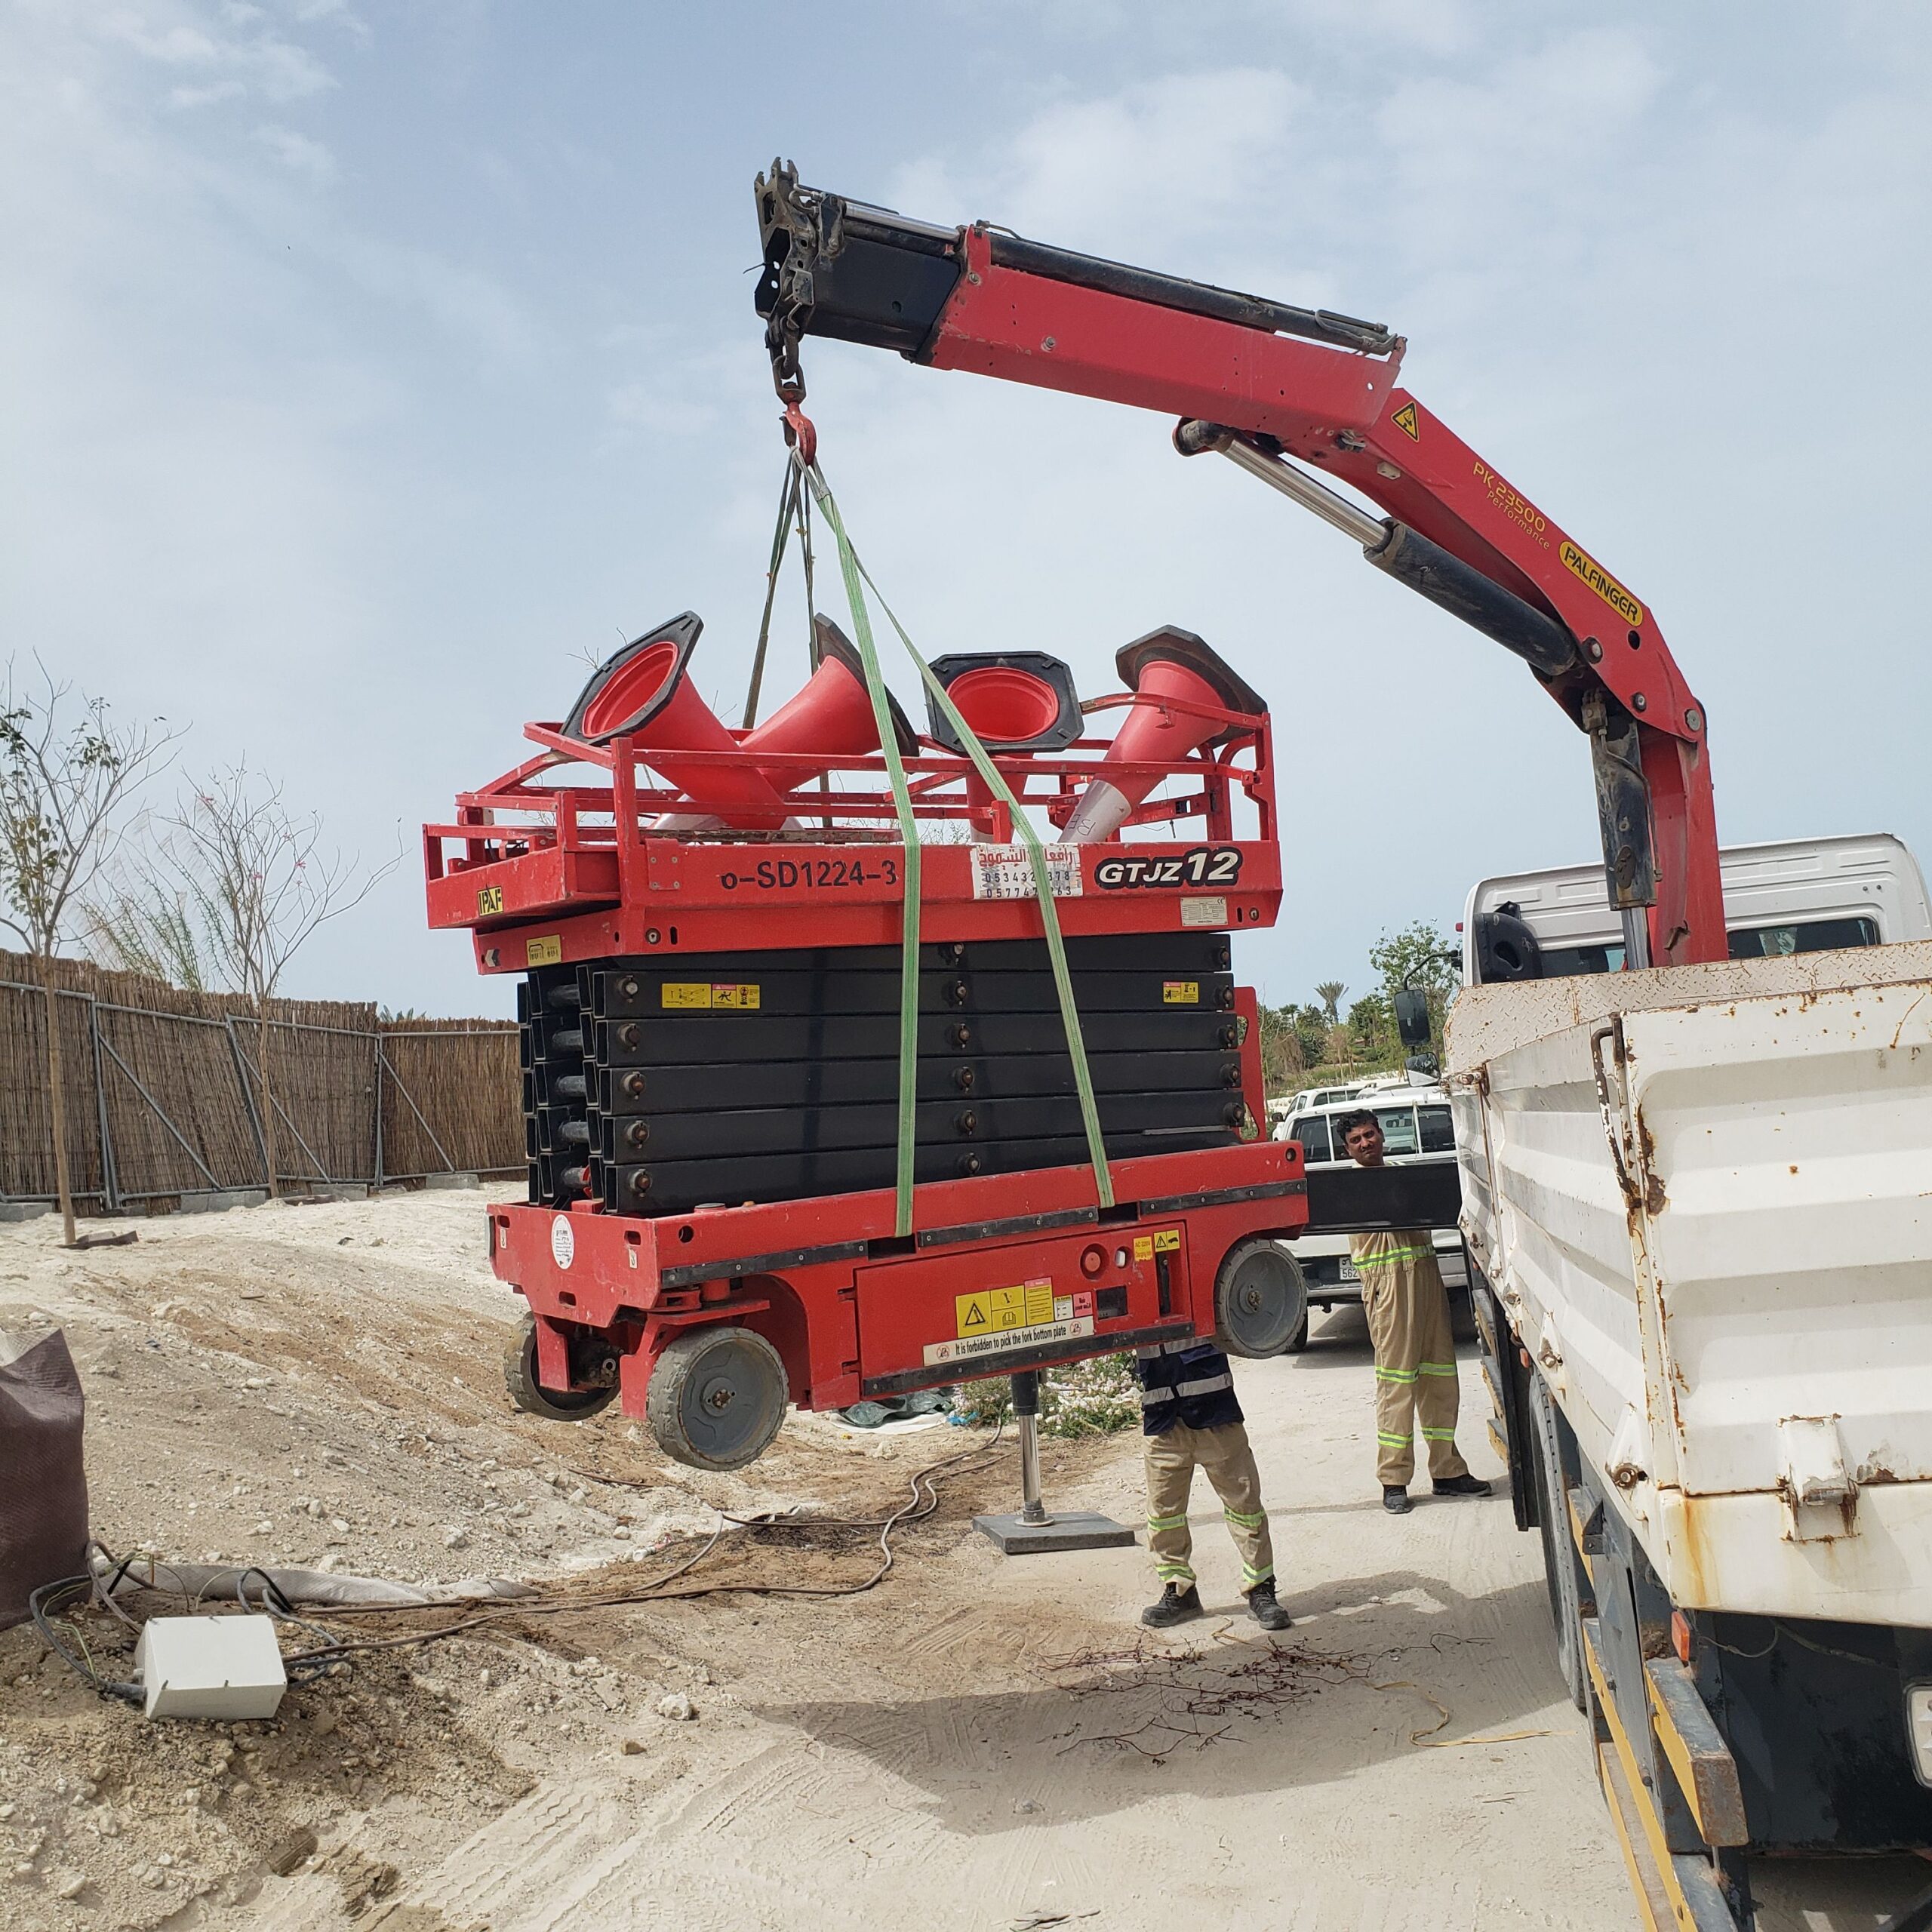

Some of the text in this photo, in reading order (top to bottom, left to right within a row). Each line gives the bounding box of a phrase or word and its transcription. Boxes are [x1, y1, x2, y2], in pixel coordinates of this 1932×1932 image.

[1473, 461, 1545, 532] PK 23500
[1487, 491, 1549, 550] Performance
[1564, 546, 1638, 622] PALFINGER
[1044, 846, 1072, 865] رافعا
[1099, 851, 1239, 883] GTJZ12
[478, 886, 502, 914] IPAF
[955, 1324, 1066, 1355] It is forbidden to pick the fork bottom plate
